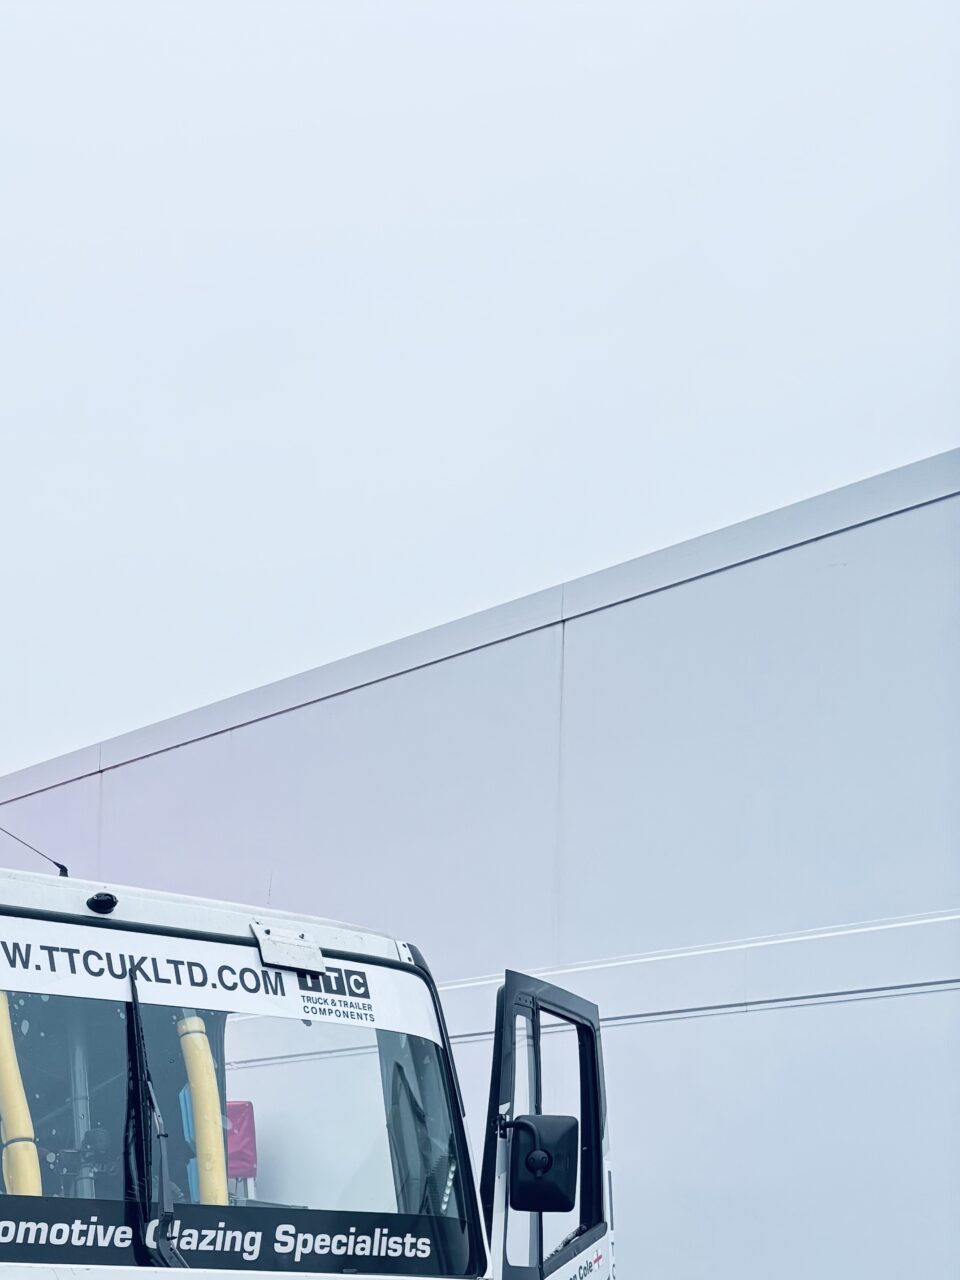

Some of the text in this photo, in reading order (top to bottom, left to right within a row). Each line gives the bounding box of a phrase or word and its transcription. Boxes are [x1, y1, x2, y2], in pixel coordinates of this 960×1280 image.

[300, 995, 373, 1012] TRUCK & TRAILER
[303, 1005, 376, 1022] COMPONENTS
[273, 1224, 431, 1262] Specialists
[578, 1260, 594, 1280] Cole
